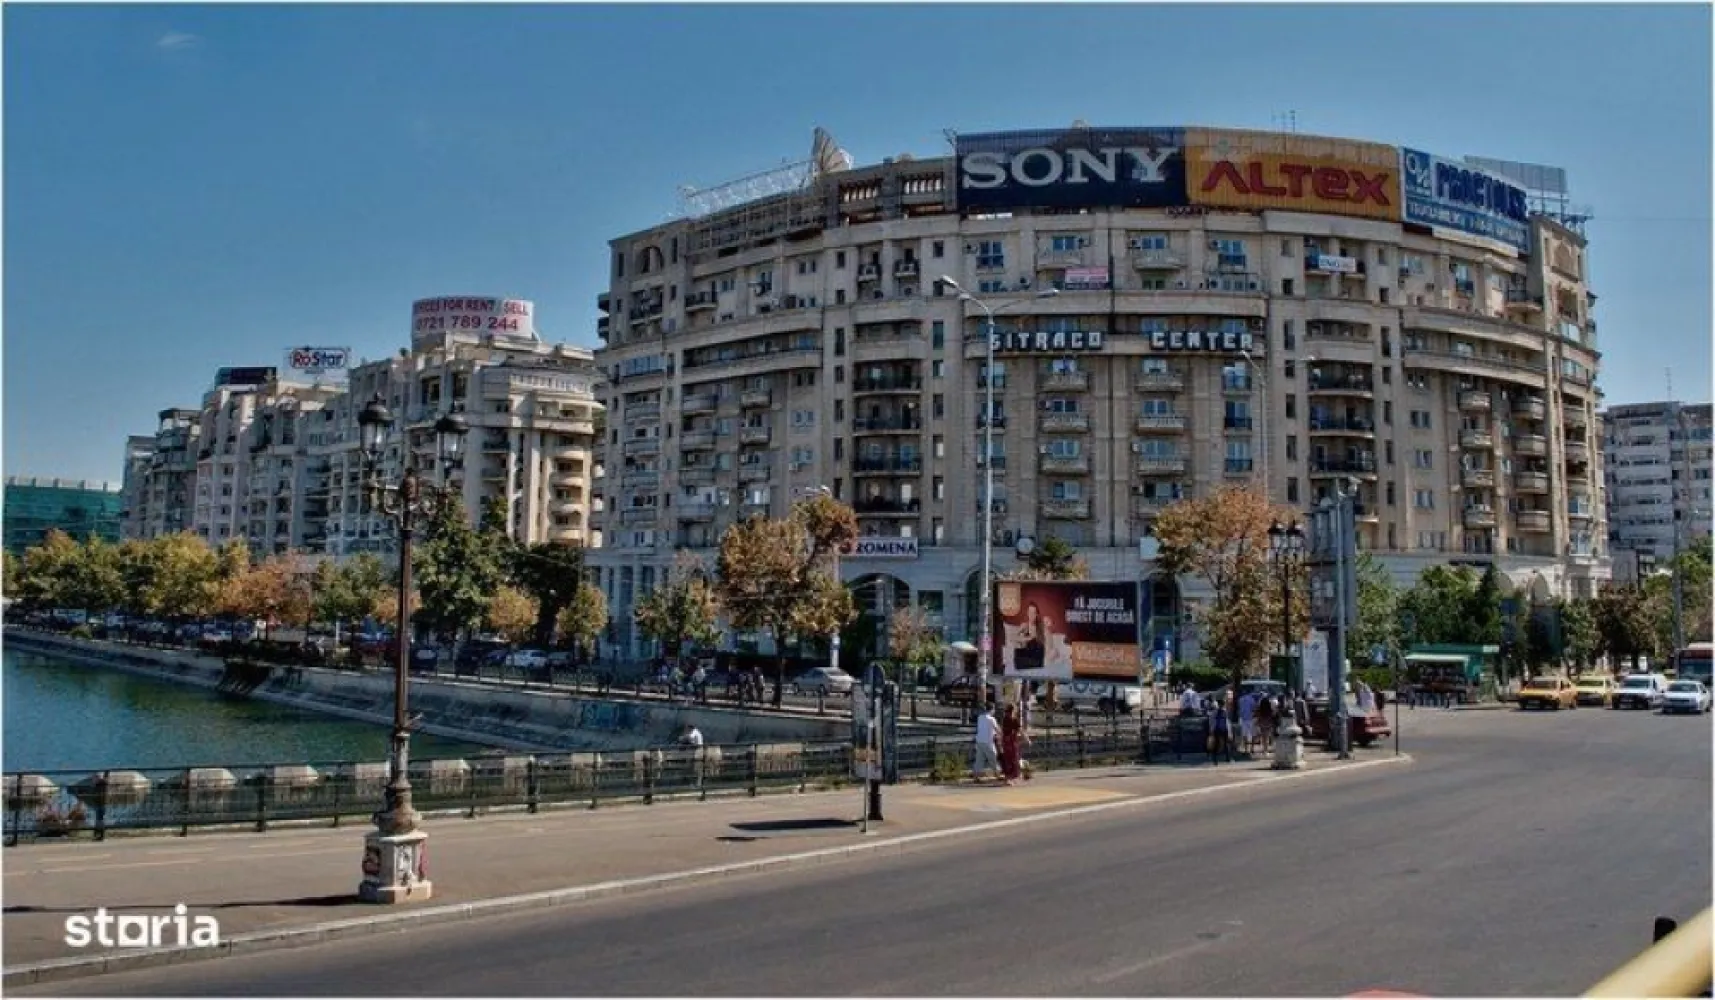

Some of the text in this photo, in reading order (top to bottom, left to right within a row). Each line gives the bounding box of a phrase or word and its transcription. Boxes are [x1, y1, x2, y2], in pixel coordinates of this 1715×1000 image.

[962, 147, 1179, 189] SONY
[466, 298, 496, 311] RENT
[451, 315, 481, 329] 789
[488, 316, 518, 331] 244
[1151, 332, 1253, 350] CENTER
